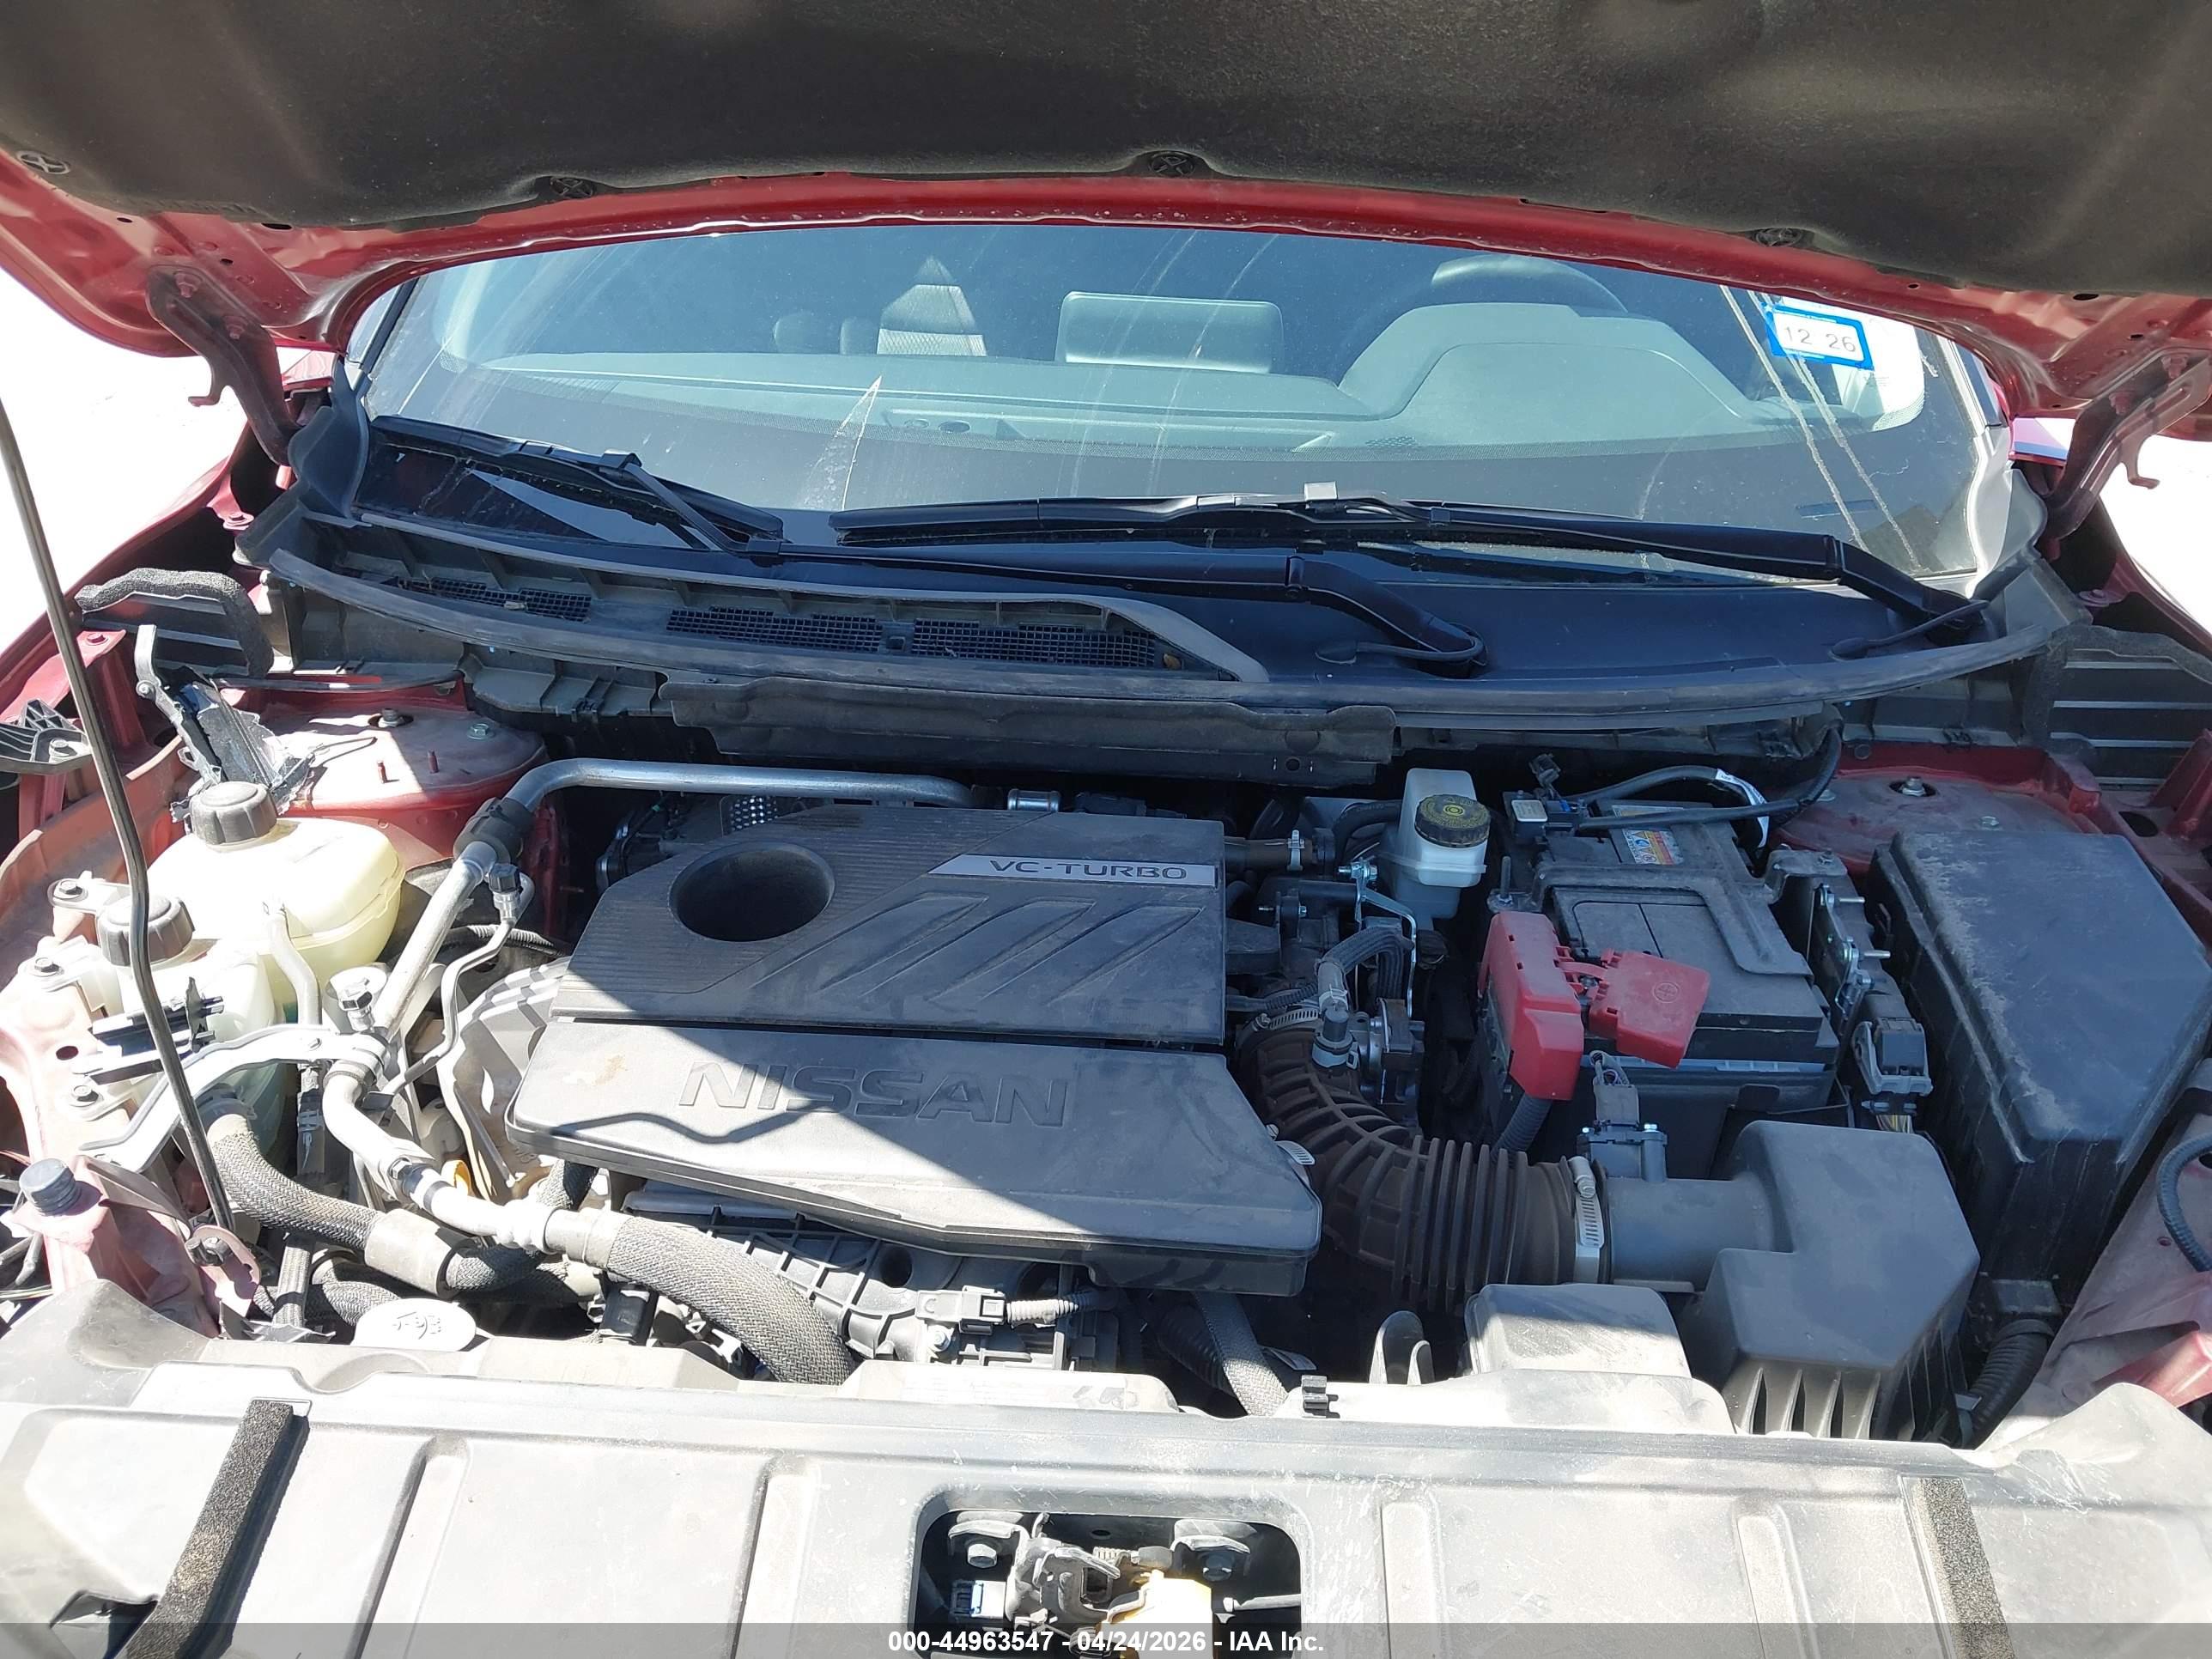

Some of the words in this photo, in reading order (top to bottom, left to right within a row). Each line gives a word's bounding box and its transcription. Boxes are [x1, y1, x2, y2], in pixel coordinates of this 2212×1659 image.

[1785, 326, 1813, 345] 12
[1826, 333, 1856, 353] 26
[989, 860, 1188, 880] VC-TURBO
[678, 1060, 1068, 1128] NISSAN
